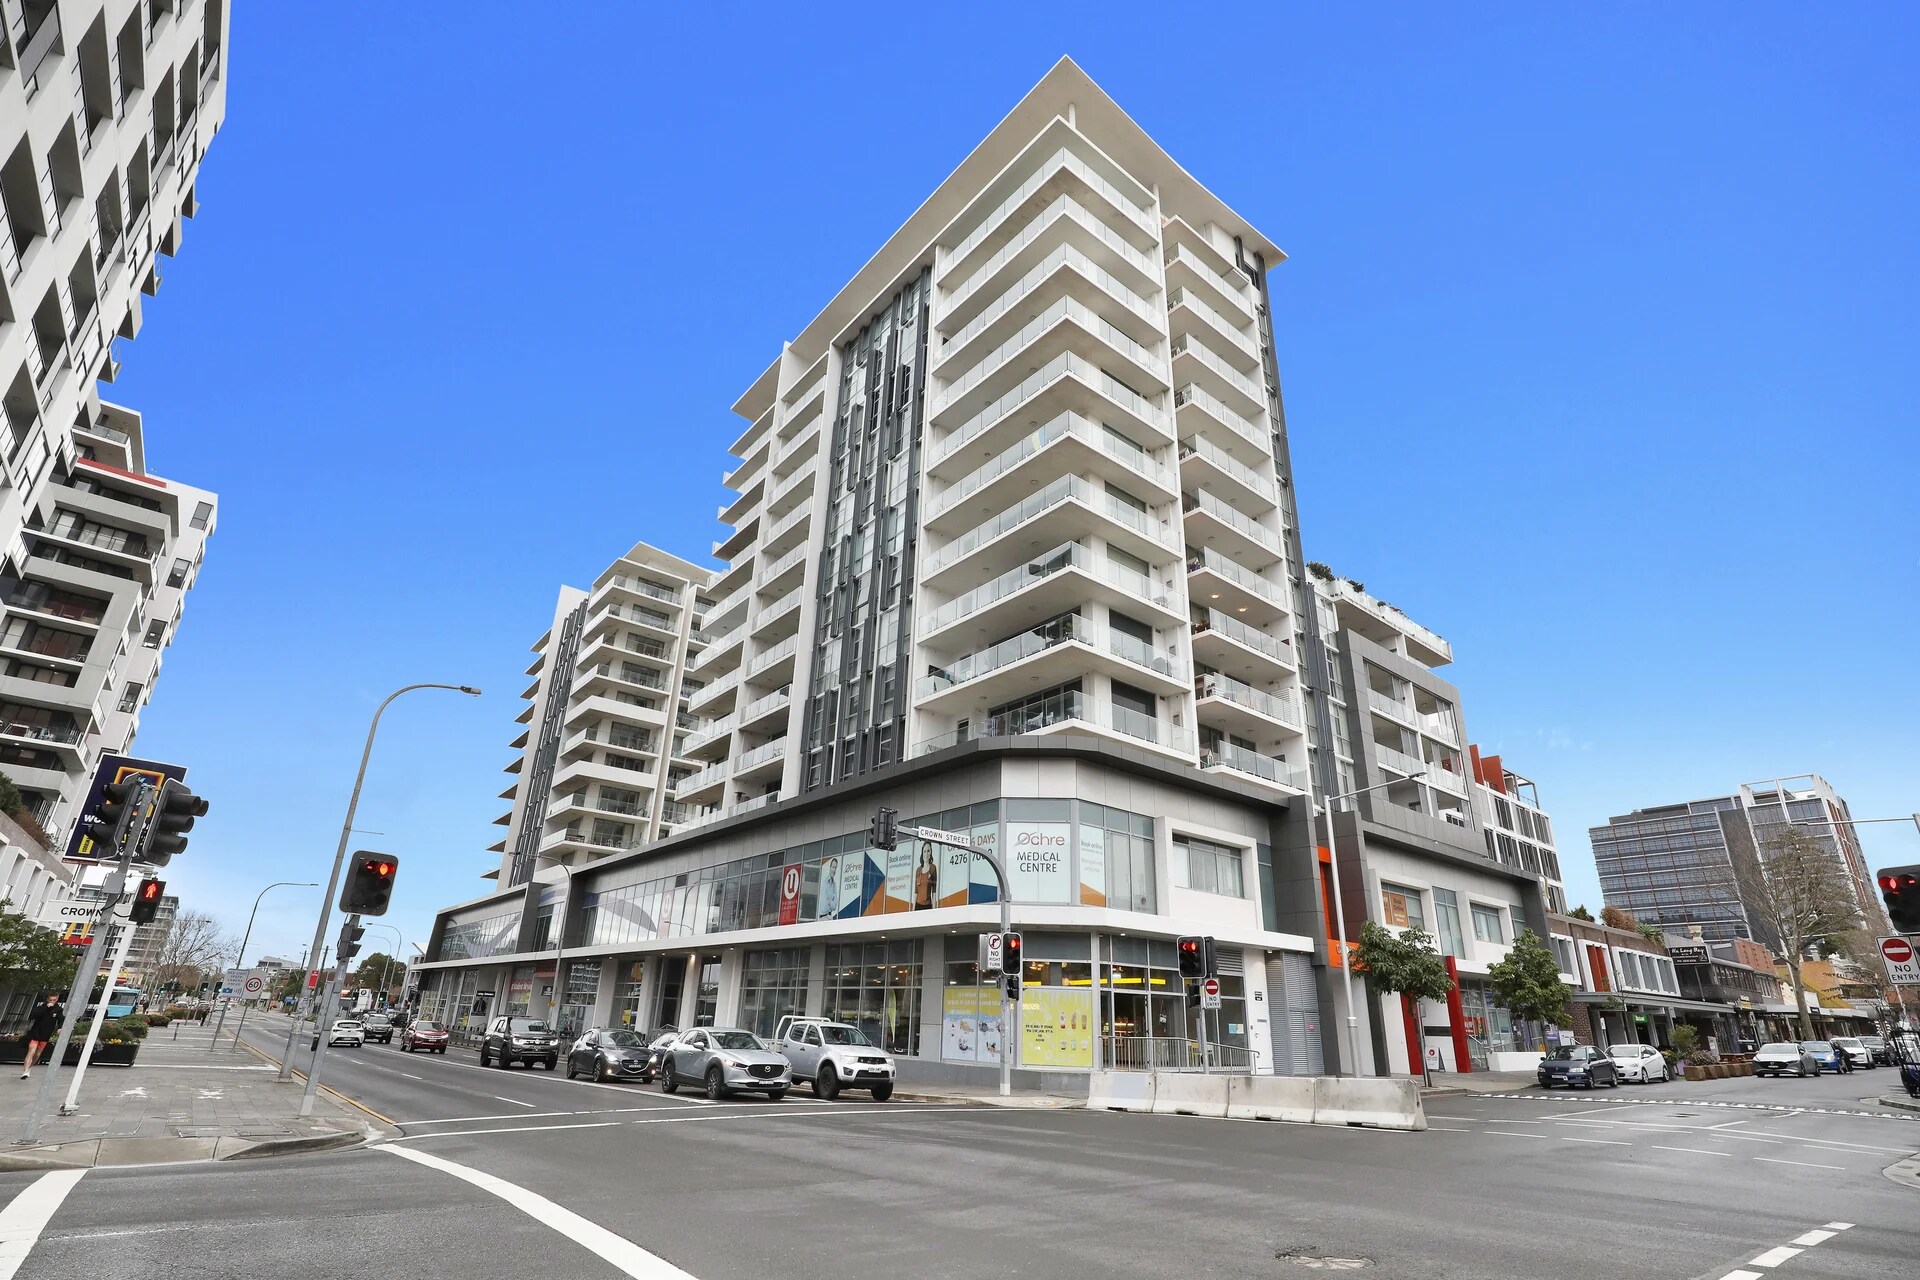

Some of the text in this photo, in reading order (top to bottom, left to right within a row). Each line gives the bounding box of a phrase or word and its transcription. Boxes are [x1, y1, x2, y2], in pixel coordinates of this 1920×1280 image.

[920, 829, 969, 845] CROWN STREET
[977, 833, 996, 845] DAYS
[889, 854, 911, 864] Book online
[949, 853, 968, 866] 4276
[1016, 852, 1061, 862] MEDICAL
[1019, 862, 1057, 873] CENTRE
[844, 882, 858, 891] CENTRE
[1894, 964, 1912, 973] NO
